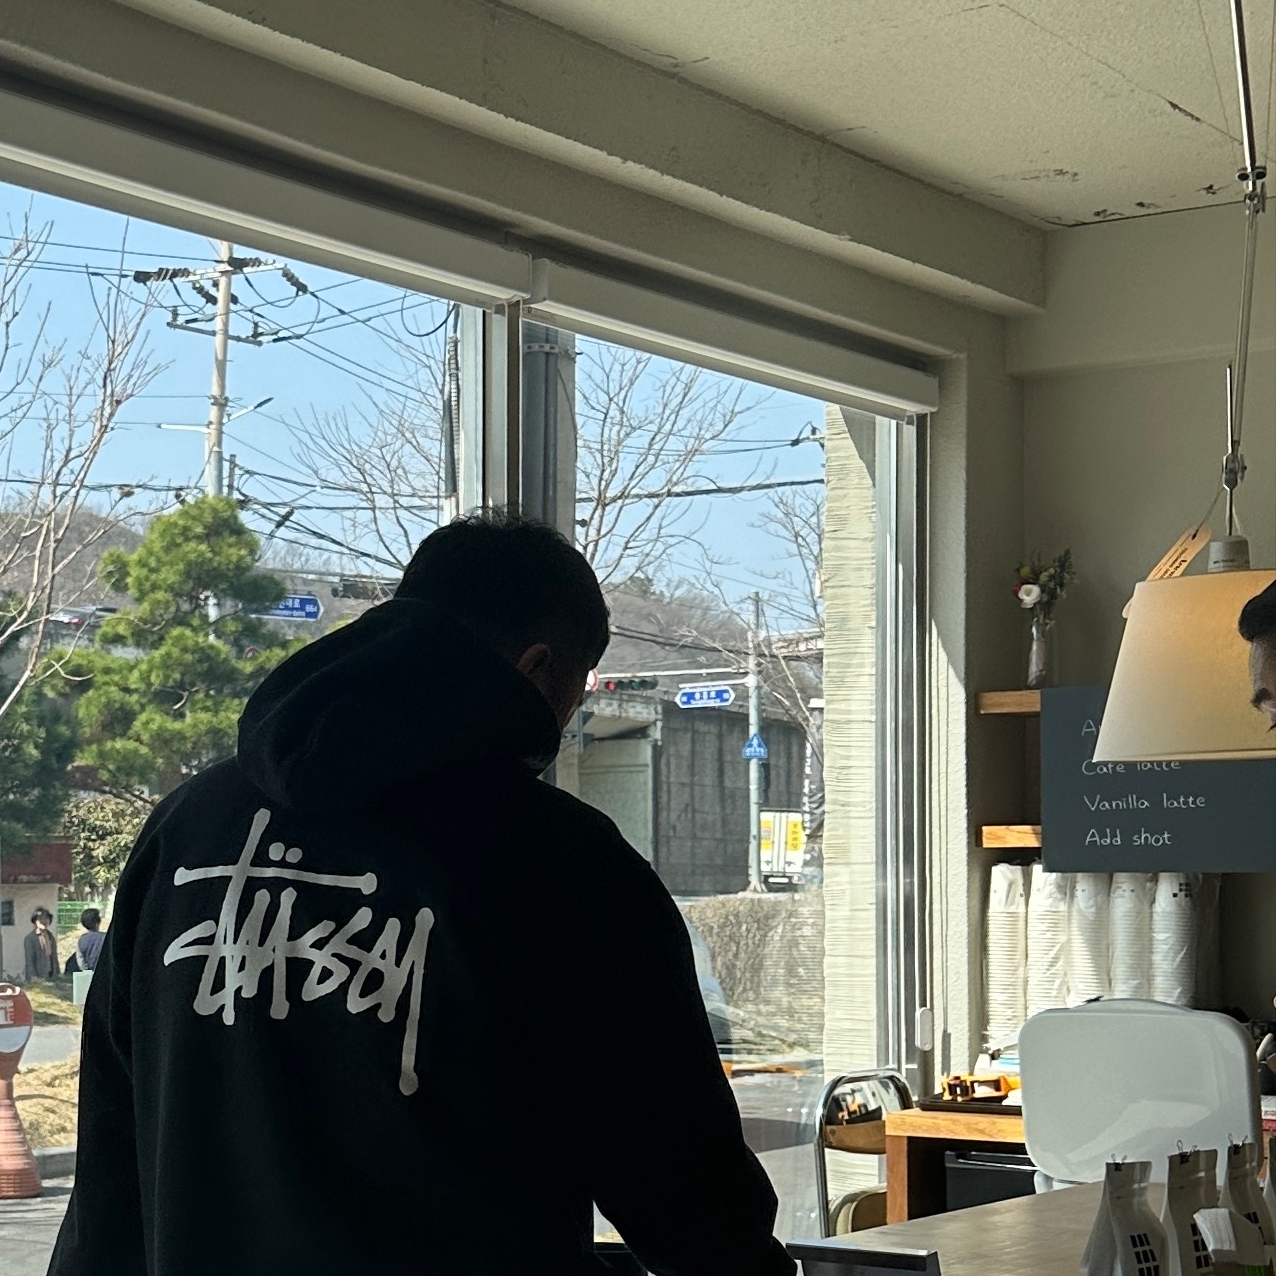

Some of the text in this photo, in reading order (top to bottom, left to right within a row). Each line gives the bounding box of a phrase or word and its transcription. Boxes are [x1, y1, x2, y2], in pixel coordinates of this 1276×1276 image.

[1083, 792, 1206, 812] Vanilla latte
[1084, 827, 1172, 847] Add shot
